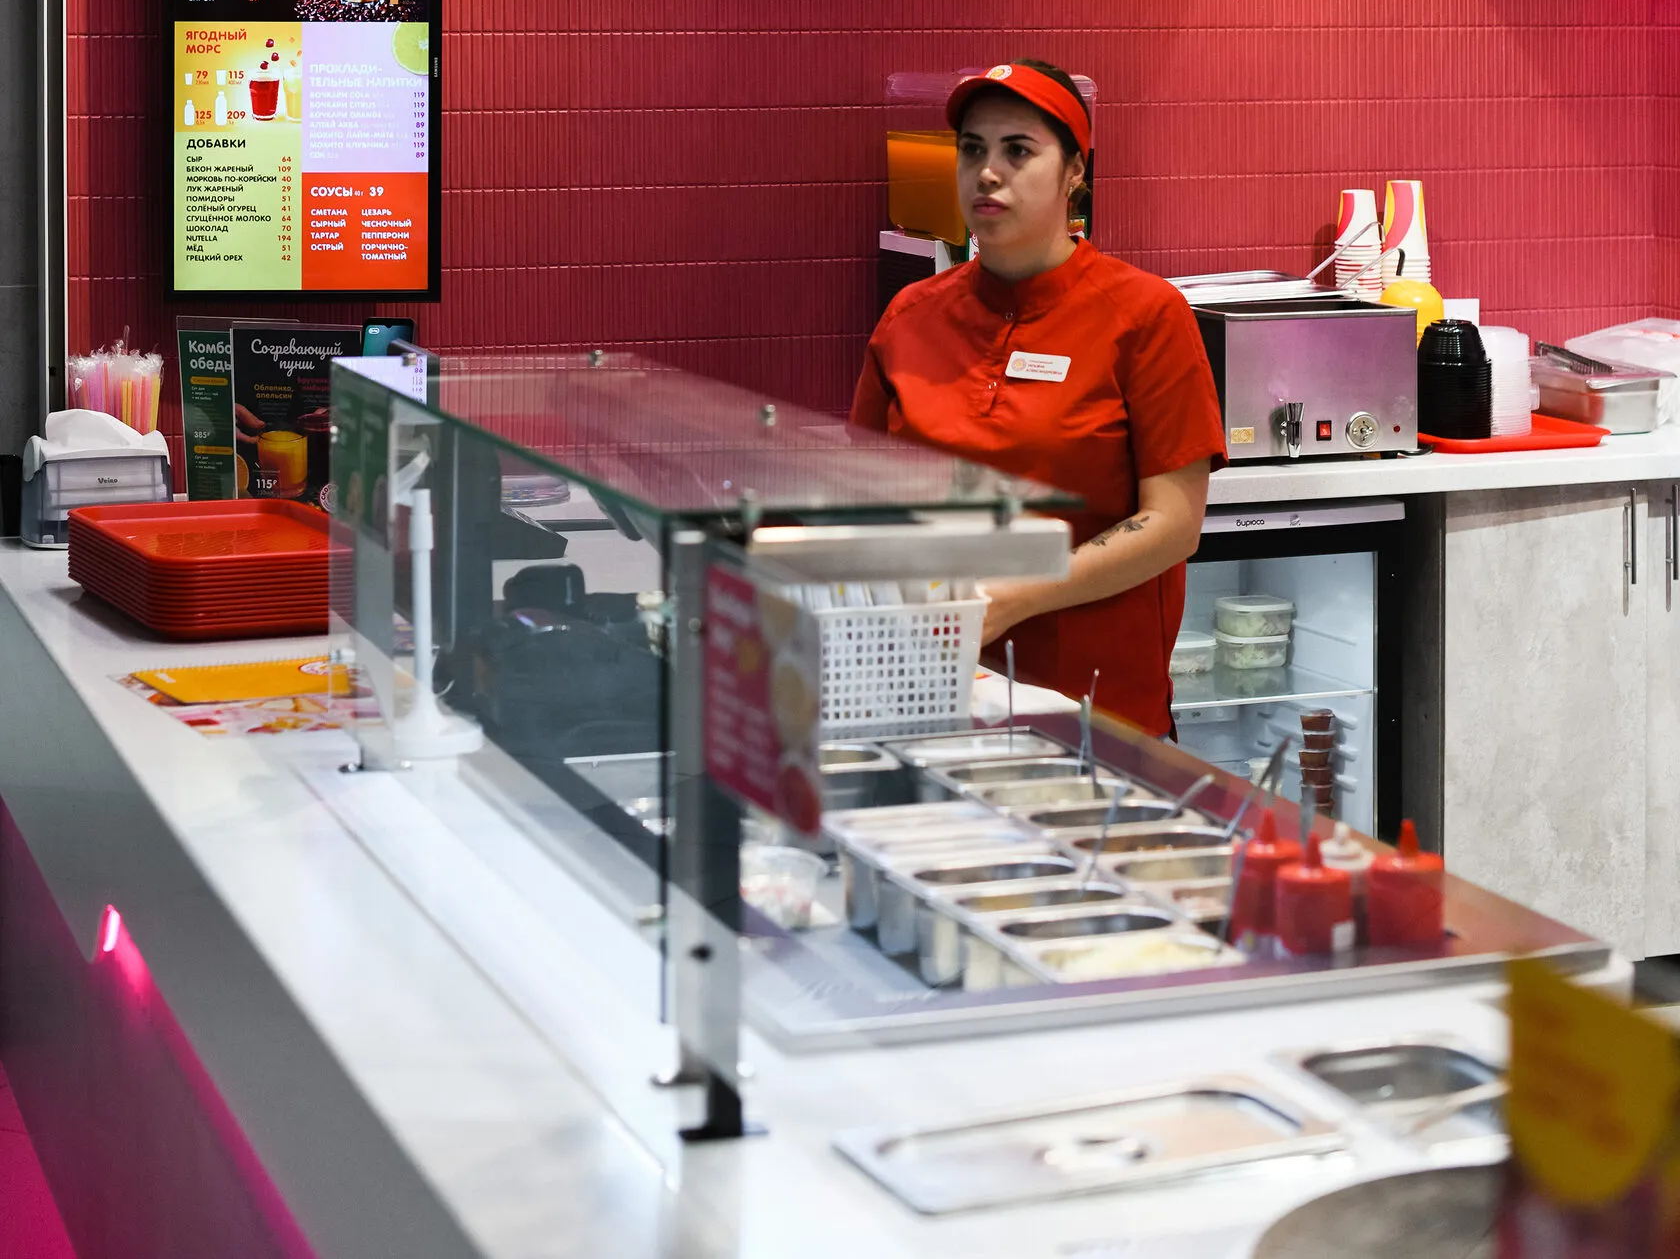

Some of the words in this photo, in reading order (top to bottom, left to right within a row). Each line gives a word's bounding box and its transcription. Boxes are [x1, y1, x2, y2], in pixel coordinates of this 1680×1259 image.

[186, 29, 246, 42] ЯГОДНЫЙ
[186, 45, 221, 53] МОРС
[310, 64, 382, 74] ПРОХЛАДИ-
[196, 71, 207, 79] 79
[229, 71, 244, 79] 115
[310, 78, 361, 87] ТЕЛЬНЫЕ
[367, 78, 421, 87] НАПИТКИ
[195, 111, 211, 119] 125
[227, 111, 245, 119] 209
[187, 139, 245, 149] ДОБАВКИ
[214, 164, 253, 172] ЖАРЕНЫЙ
[225, 174, 276, 182] ПО-КОРЕЙСКИ
[204, 184, 243, 192] ЖАРЕНЫЙ
[311, 187, 352, 197] СОУСЫ
[370, 187, 383, 197] 39
[187, 204, 225, 212] СОЛЁНЫЙ
[362, 209, 391, 217] ЦЕЗАРЬ
[311, 219, 346, 228] СЫРНЫЙ
[362, 219, 411, 227] ЧЕСНОЧНЫЙ
[187, 244, 203, 252] МЁД
[311, 242, 343, 251] ОСТРЫЙ
[187, 253, 221, 262] ГРЕЦКИЙ
[362, 251, 406, 260] ТОМАТНЫЙ
[251, 338, 343, 361] Согревающий
[280, 360, 315, 376] пунш
[254, 384, 293, 392] Облепиха,
